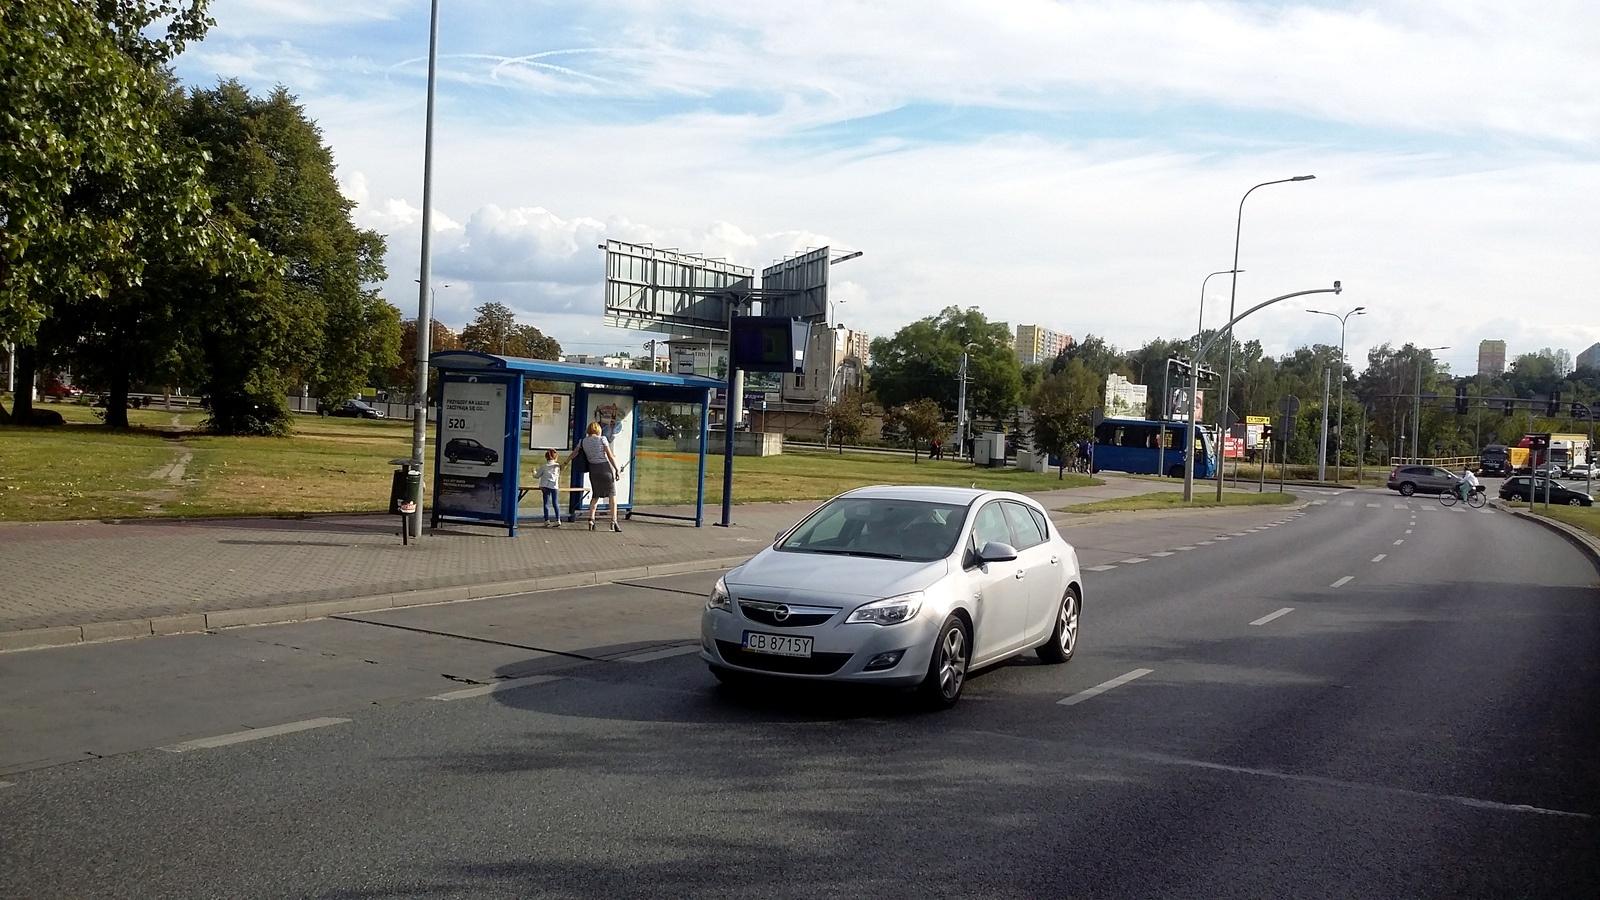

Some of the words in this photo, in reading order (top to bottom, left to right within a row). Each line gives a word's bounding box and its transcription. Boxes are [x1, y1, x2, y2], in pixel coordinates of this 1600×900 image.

[448, 418, 466, 429] 520
[750, 634, 766, 649] CB
[770, 636, 810, 653] 8715Y
